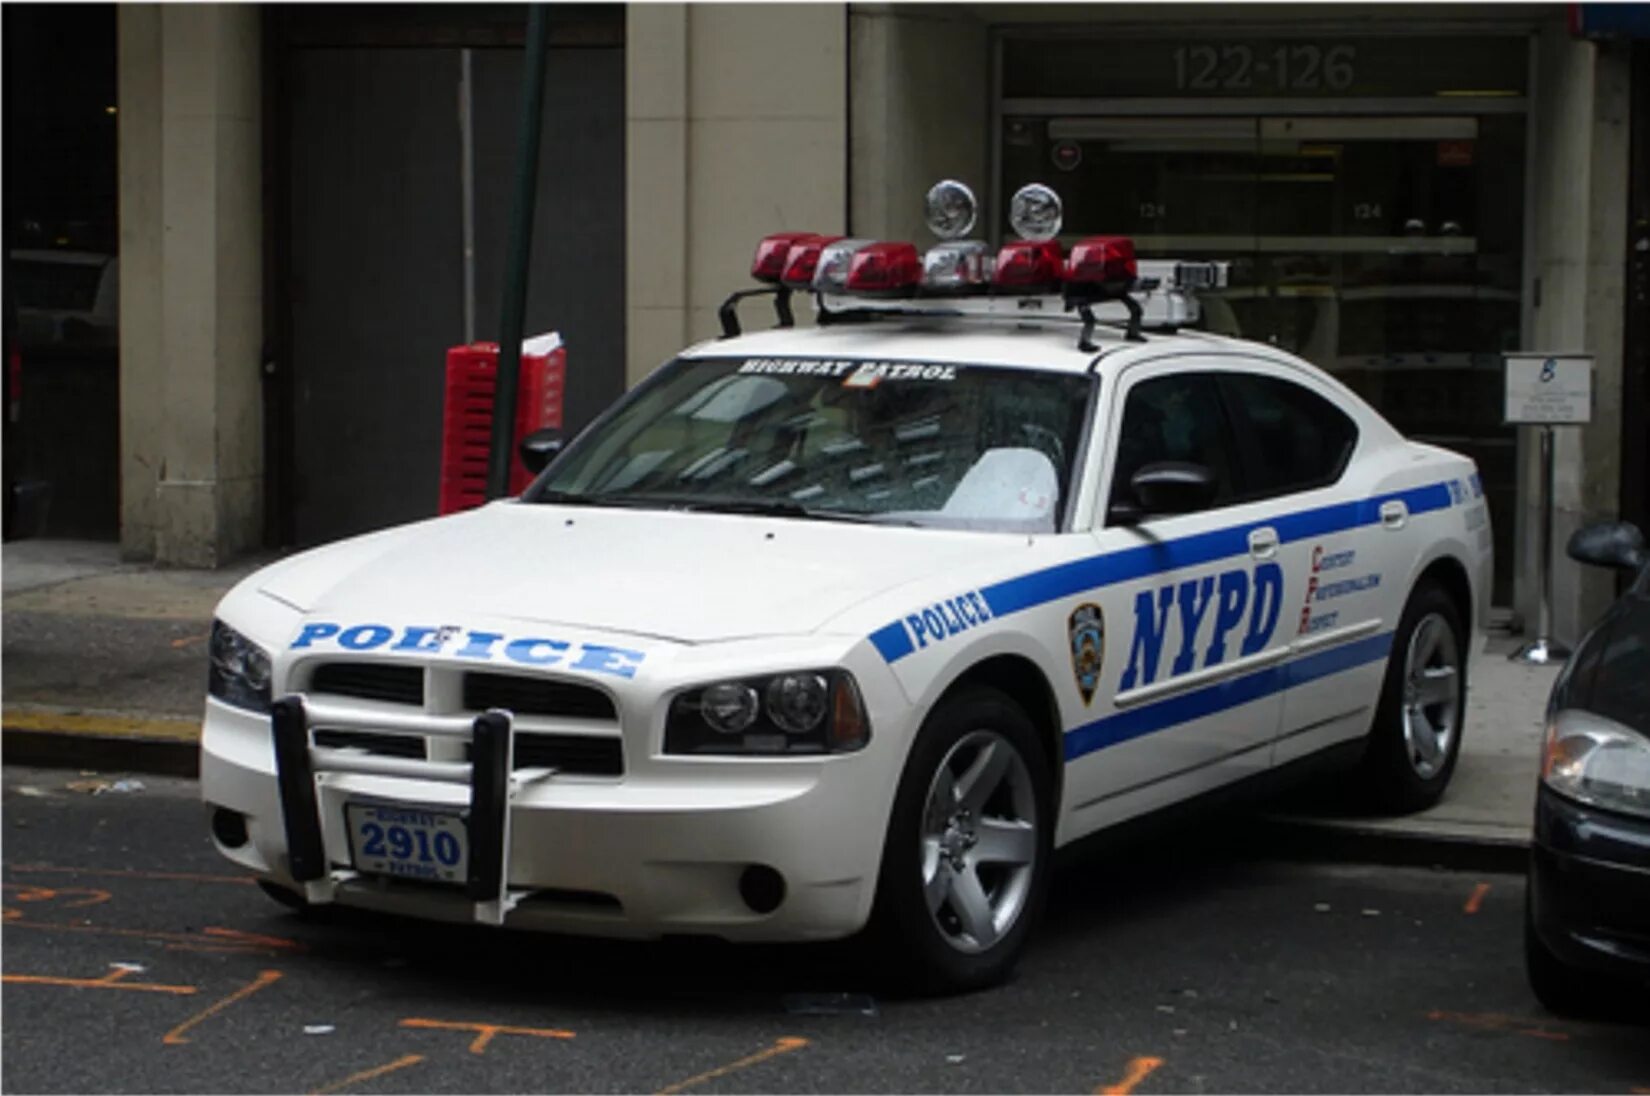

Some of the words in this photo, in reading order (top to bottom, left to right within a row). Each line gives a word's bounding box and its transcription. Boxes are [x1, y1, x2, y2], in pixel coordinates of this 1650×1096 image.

[1173, 45, 1356, 89] 122-126
[738, 358, 852, 377] HIGHWAY
[856, 361, 957, 381] PATROL
[905, 591, 990, 648] POLICE
[1118, 562, 1283, 693] NYPD
[289, 622, 646, 679] POLICE
[360, 821, 461, 867] 2910
